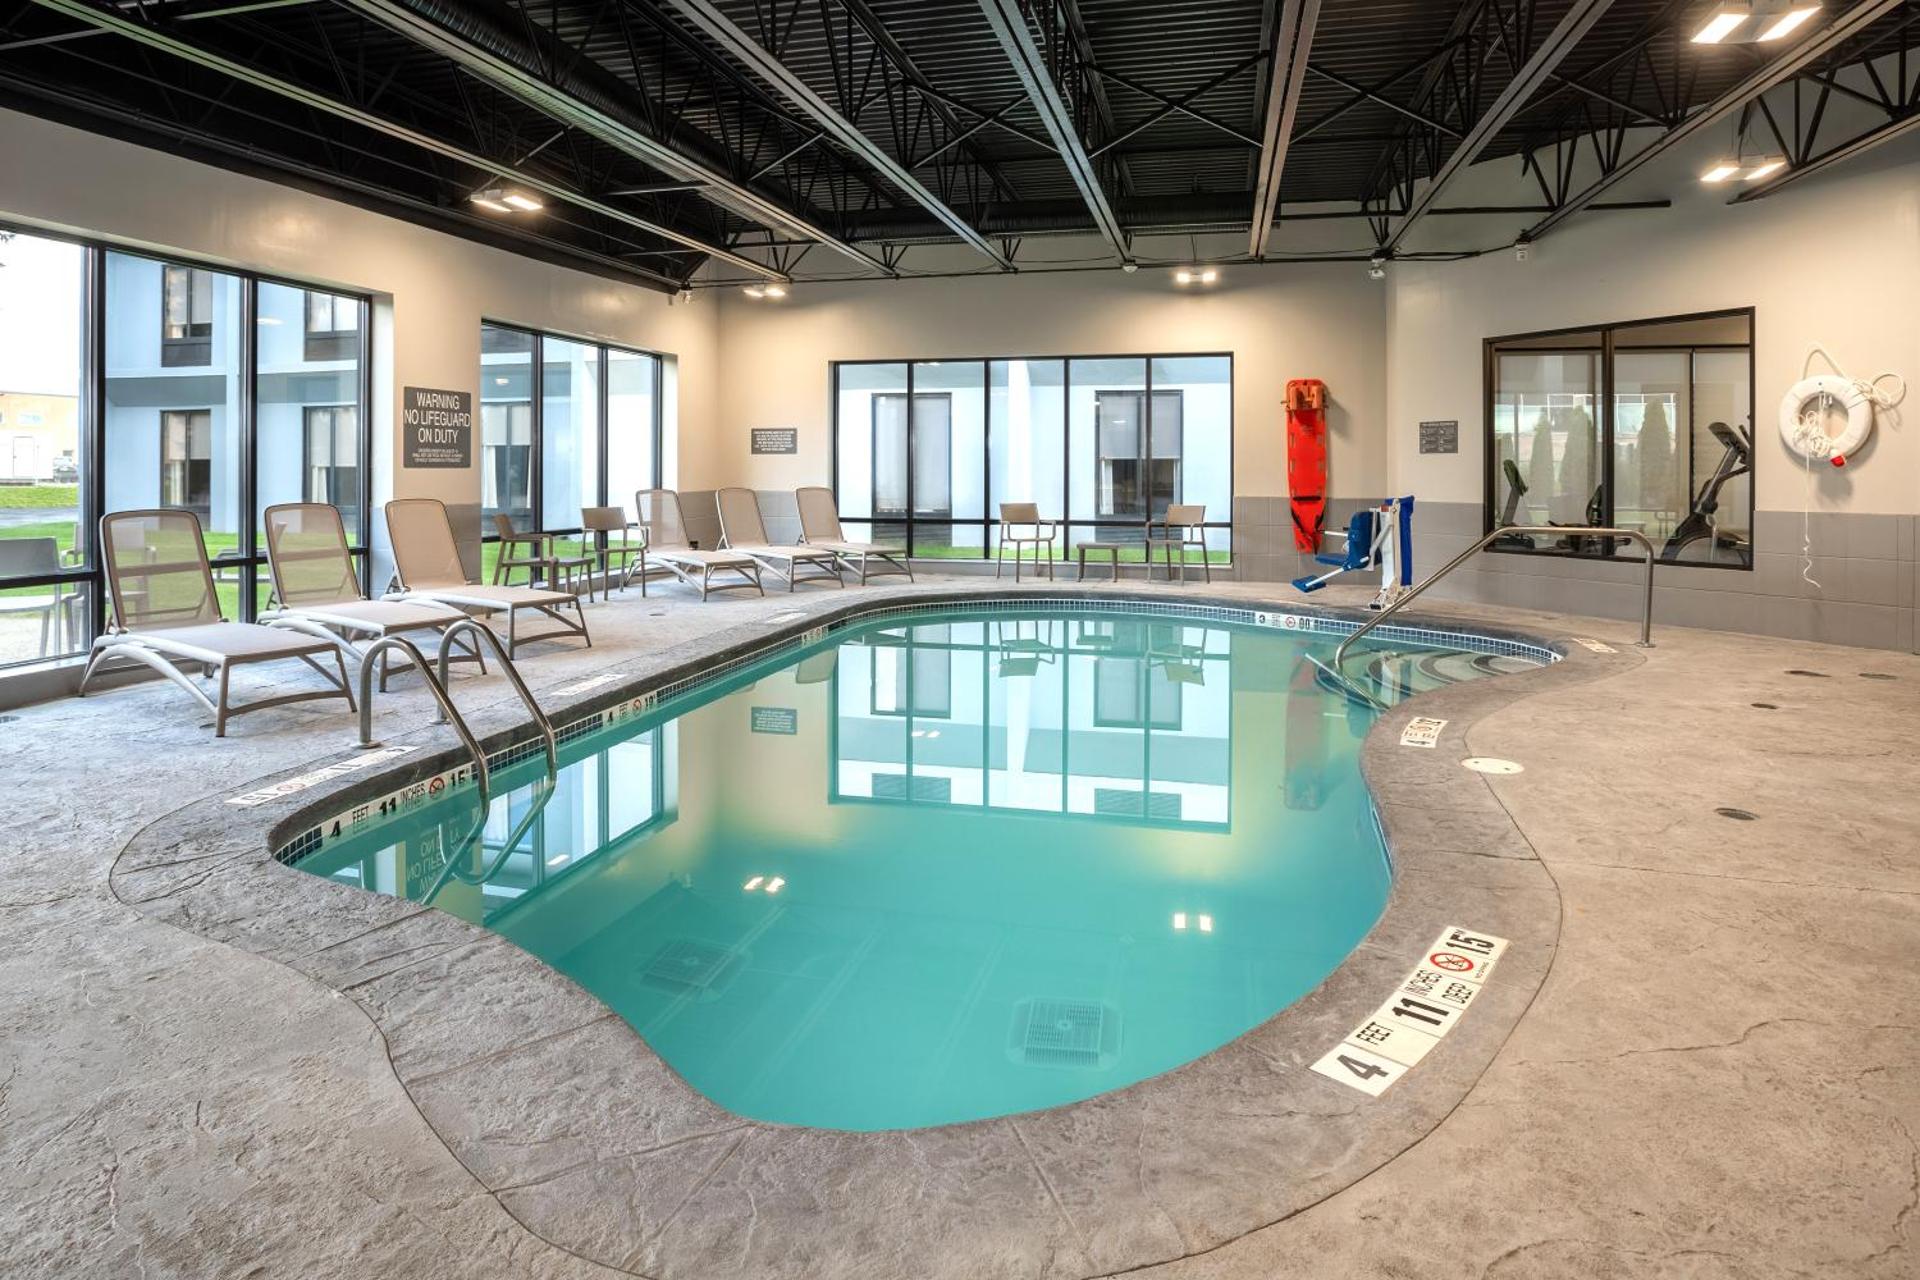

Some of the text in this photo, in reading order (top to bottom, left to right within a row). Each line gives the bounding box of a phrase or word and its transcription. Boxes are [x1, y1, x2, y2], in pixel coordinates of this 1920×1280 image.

[416, 392, 460, 410] WARNING
[404, 409, 471, 427] NO LIFEGUARD
[418, 428, 460, 444] ON DUTY
[329, 820, 341, 838] 4
[352, 806, 369, 824] FEET
[379, 797, 397, 815] 11
[1441, 982, 1473, 1004] DEEP
[1392, 997, 1450, 1026] 11
[1356, 1021, 1393, 1045] FEET
[1336, 1054, 1389, 1080] 4
